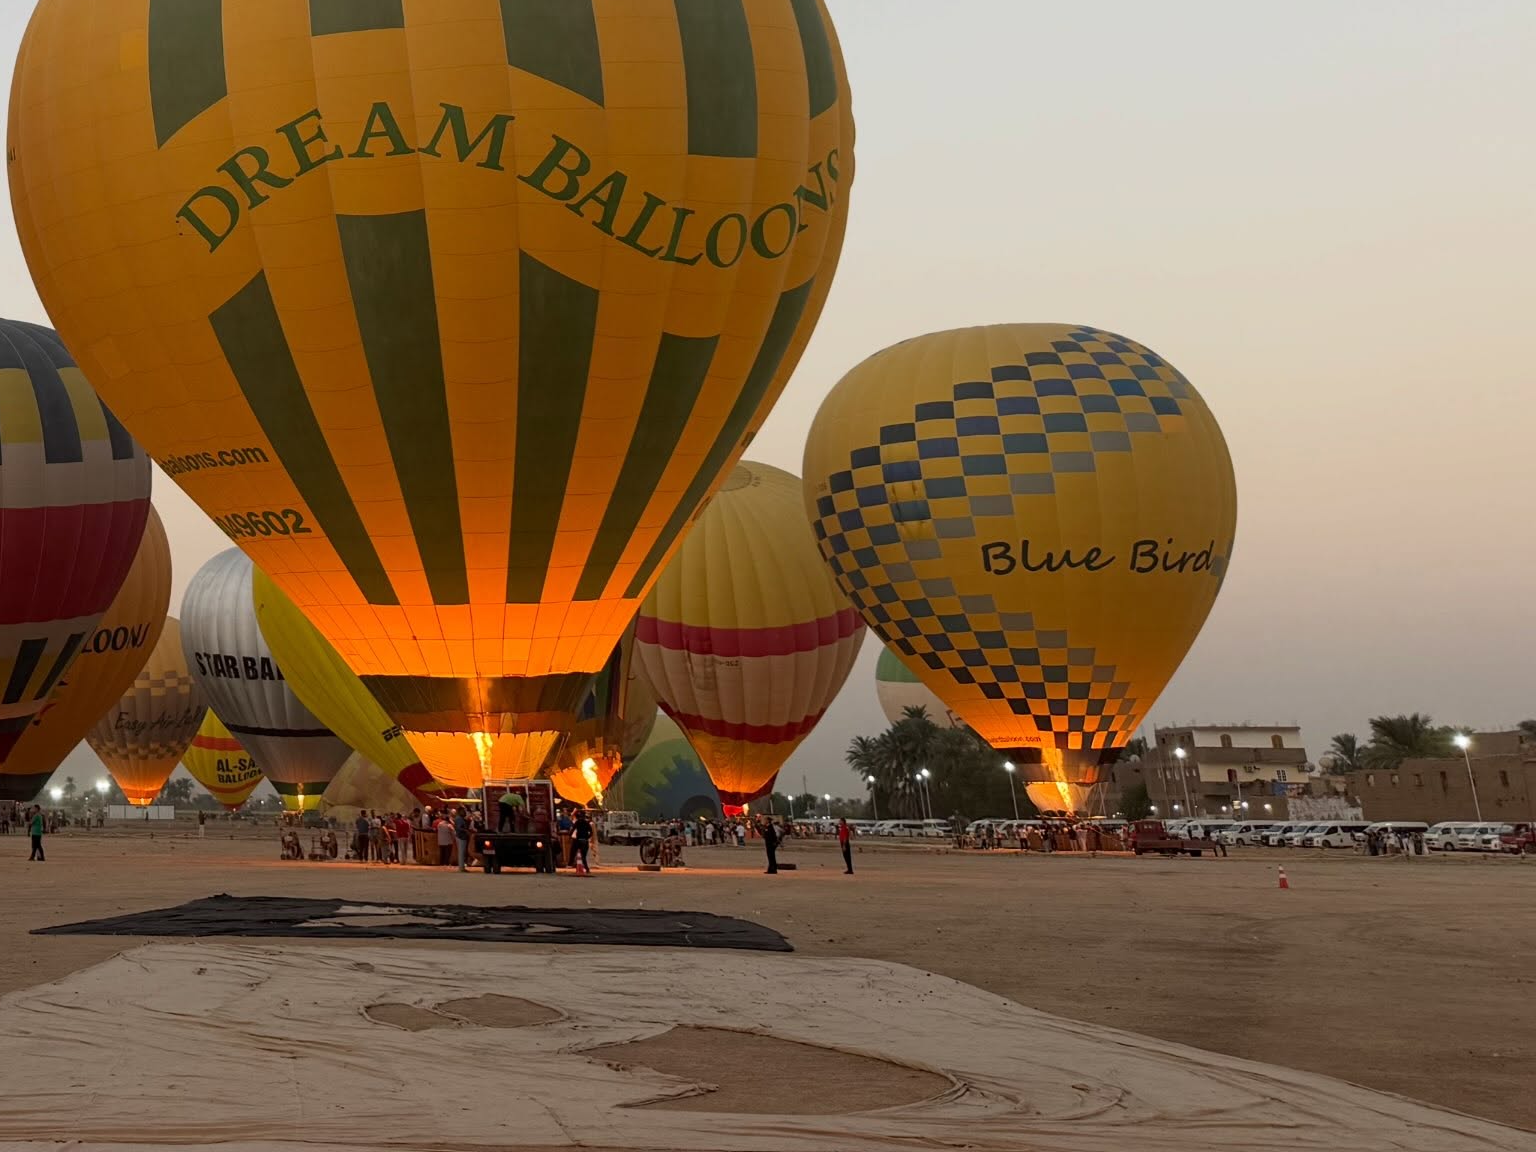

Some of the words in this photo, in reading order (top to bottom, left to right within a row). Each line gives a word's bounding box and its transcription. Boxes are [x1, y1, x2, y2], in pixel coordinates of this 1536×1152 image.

[175, 101, 516, 254] DREAM
[517, 133, 840, 269] BALLOONS
[981, 539, 1116, 576] Blue
[1129, 538, 1215, 574] Bird
[195, 652, 240, 679] STAR
